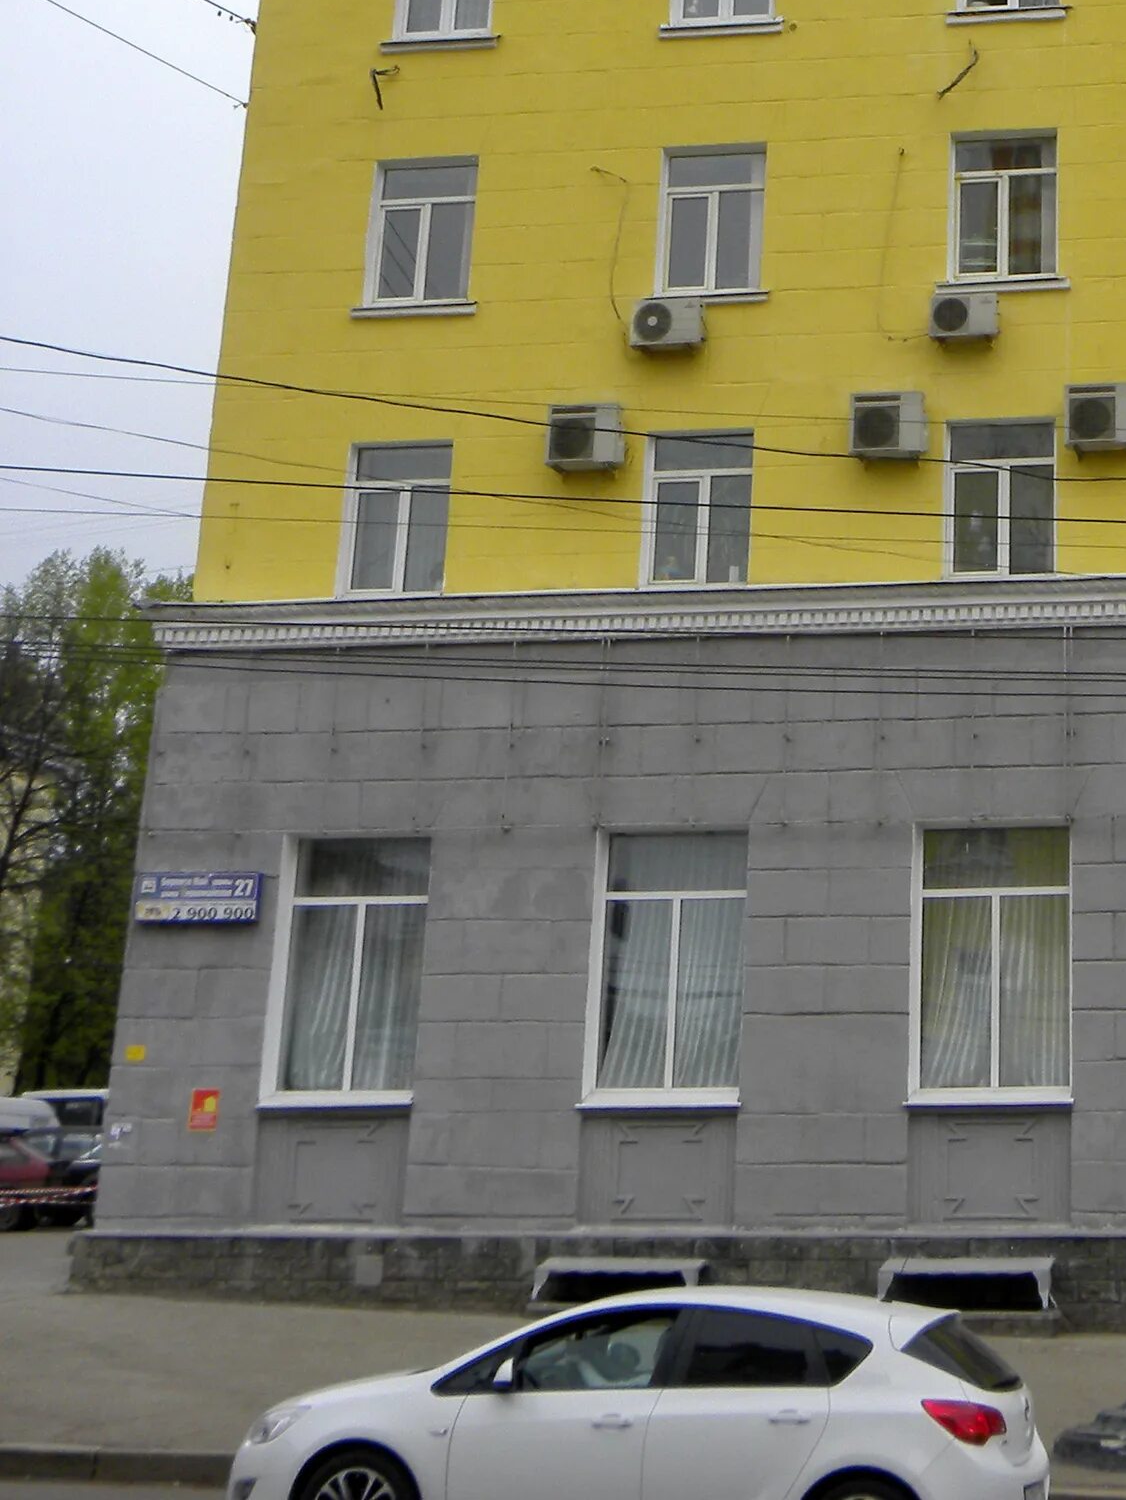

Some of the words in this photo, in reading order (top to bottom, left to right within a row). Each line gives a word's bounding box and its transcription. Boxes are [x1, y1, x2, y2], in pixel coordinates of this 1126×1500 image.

[233, 879, 254, 896] 27
[187, 906, 218, 919] 900
[223, 906, 255, 919] 900
